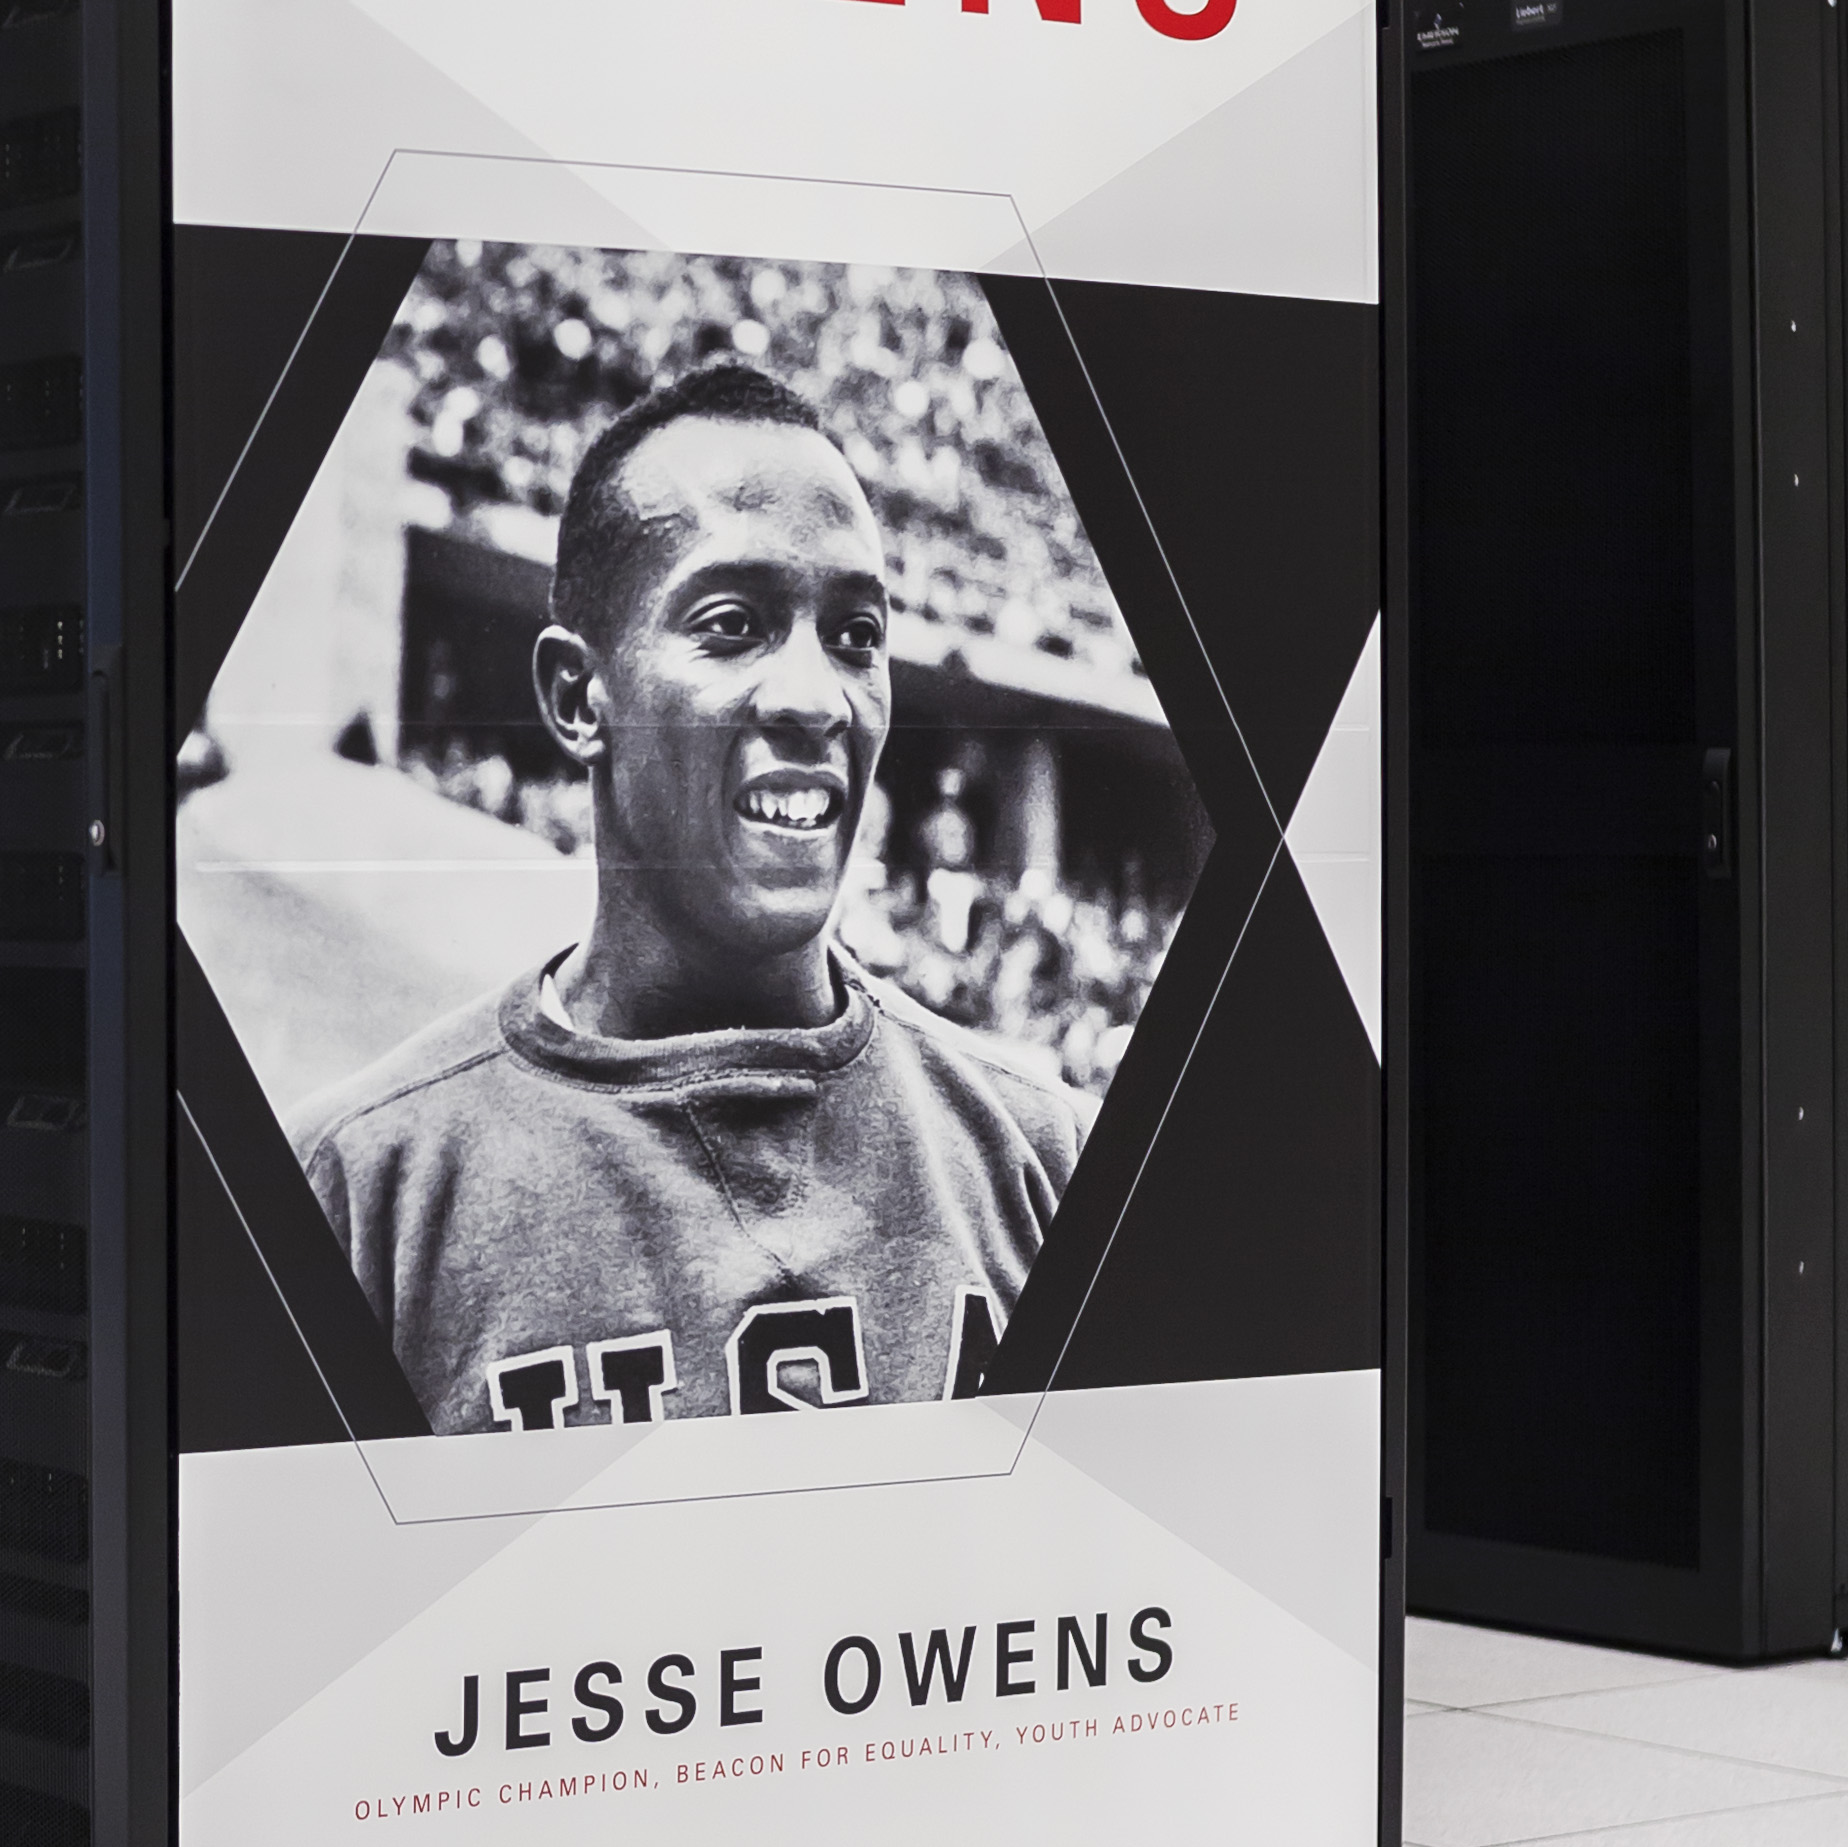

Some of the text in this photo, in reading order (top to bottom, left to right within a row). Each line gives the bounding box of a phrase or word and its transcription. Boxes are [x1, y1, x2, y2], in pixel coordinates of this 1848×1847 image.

[434, 1606, 1174, 1757] JESSE OWENS
[355, 1703, 1240, 1820] OLYMPIC CHAMPION, BEACON FOR EQUALITY, YOUTH ADVOCATE
